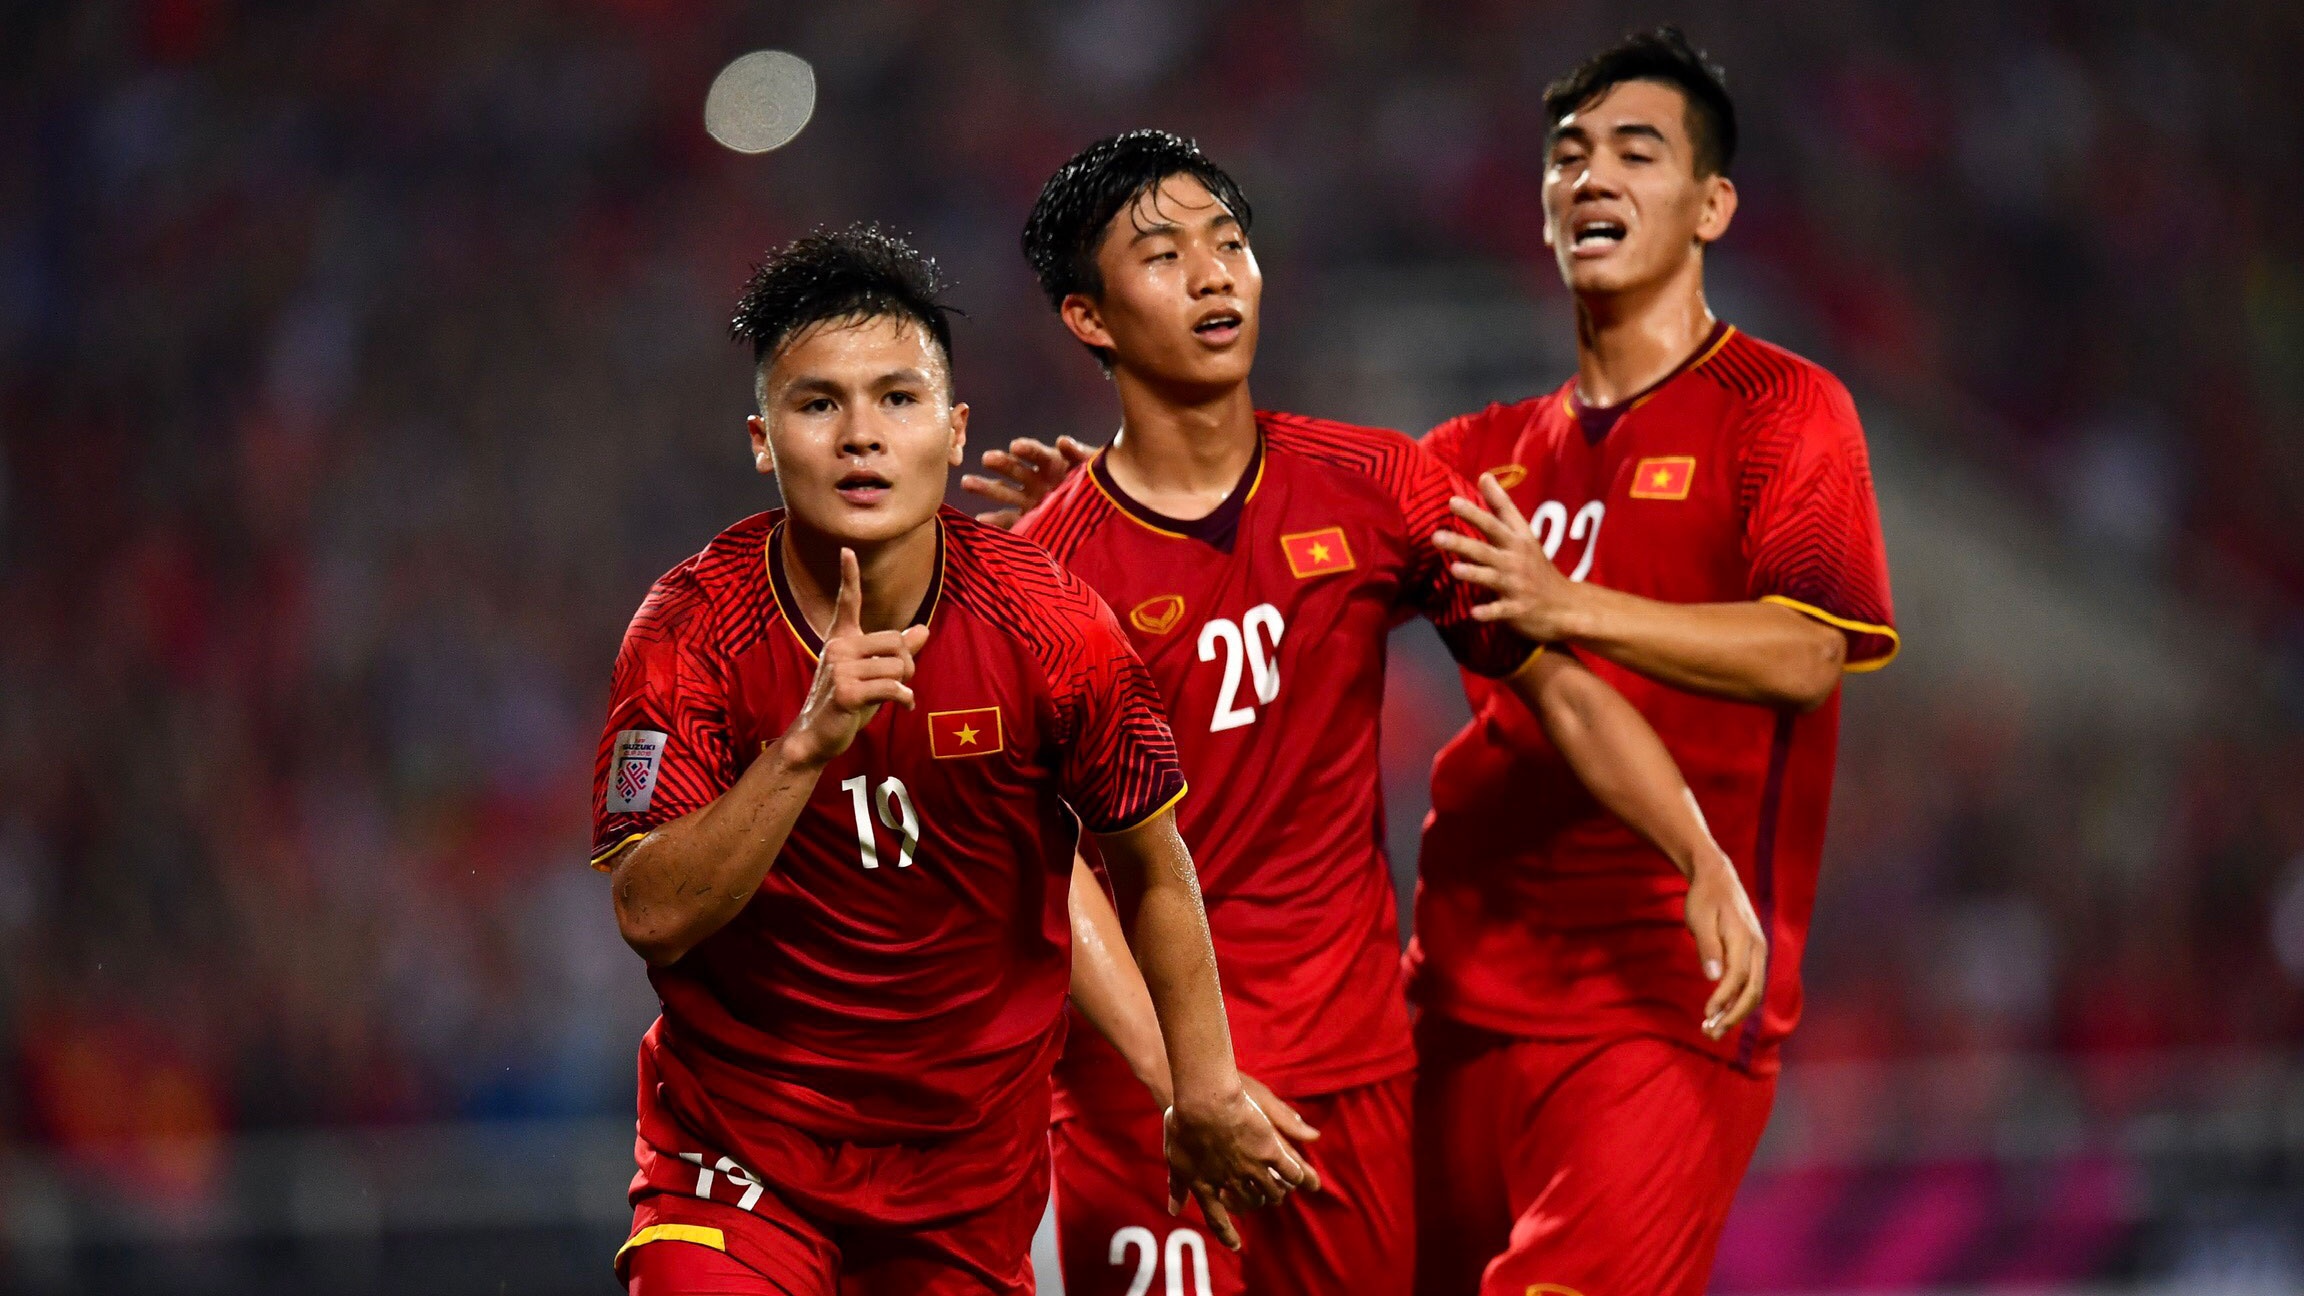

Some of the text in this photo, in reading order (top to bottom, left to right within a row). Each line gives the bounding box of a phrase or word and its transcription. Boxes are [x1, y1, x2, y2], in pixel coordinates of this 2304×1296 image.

[1197, 603, 1285, 733] 20
[842, 775, 919, 868] 19
[679, 1152, 764, 1212] 19
[1108, 1226, 1214, 1296] 20
